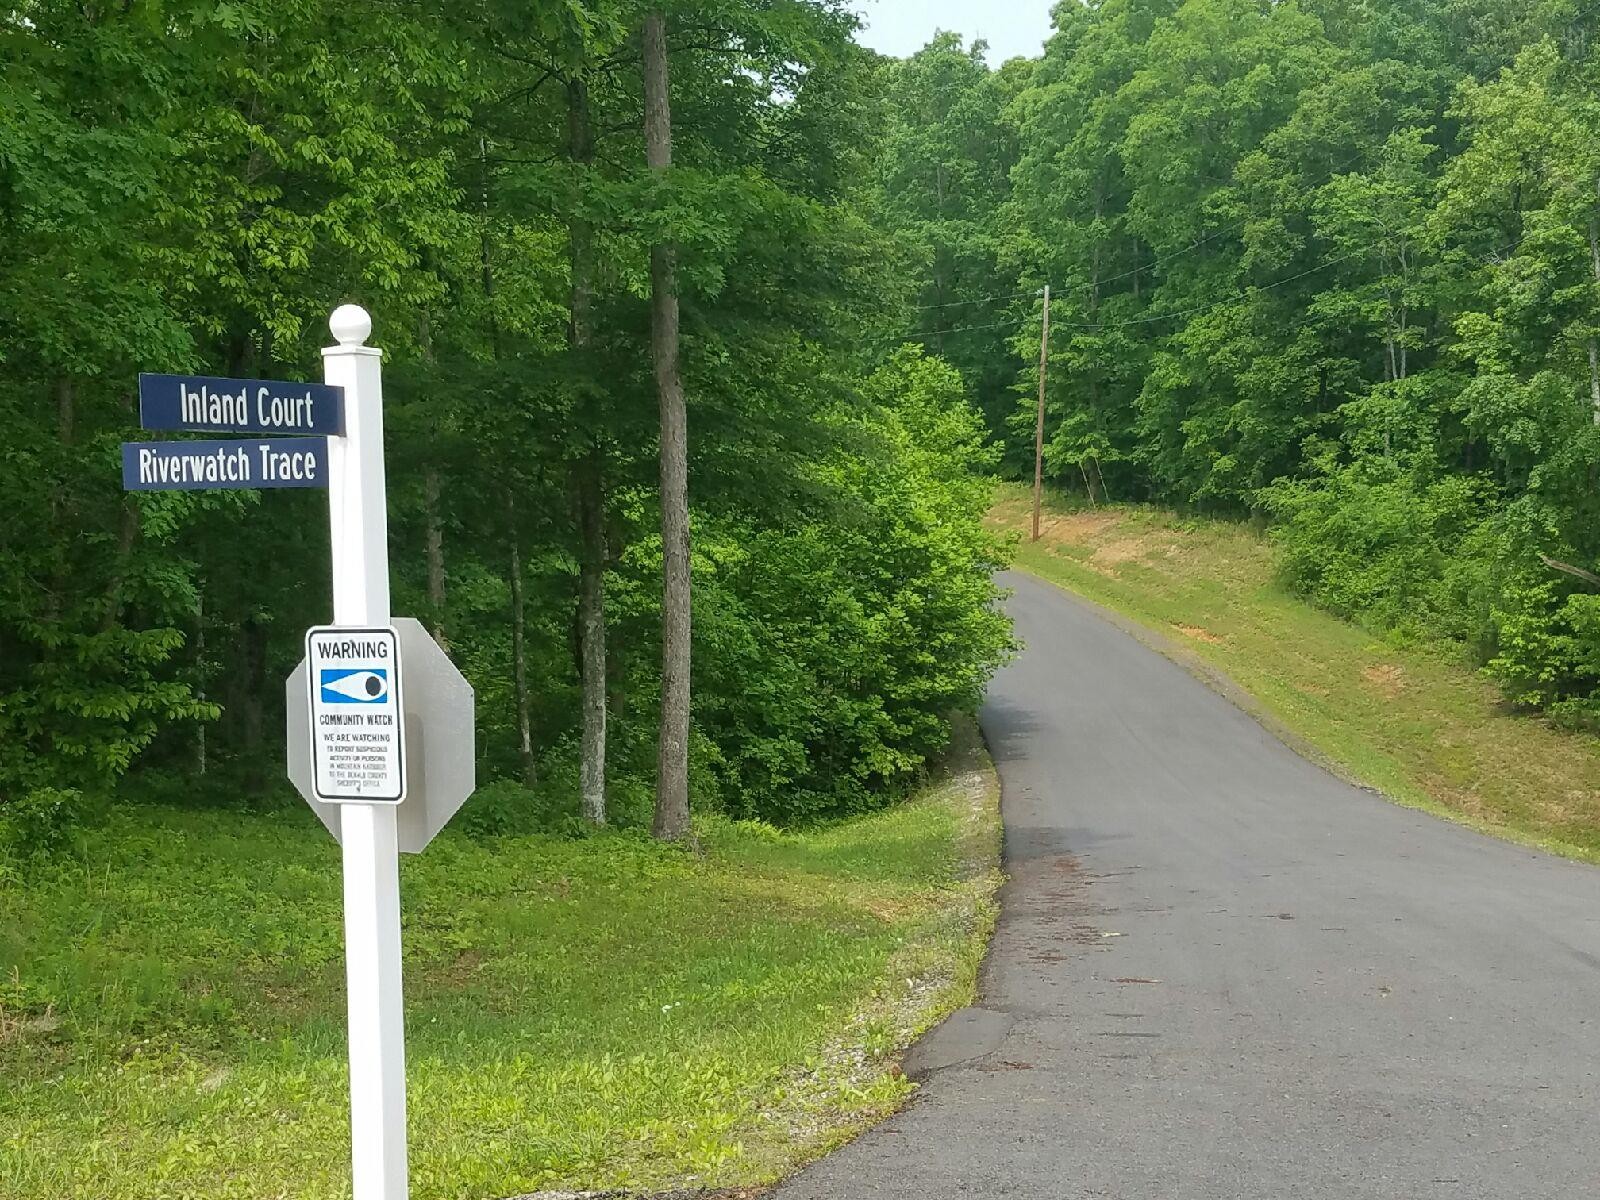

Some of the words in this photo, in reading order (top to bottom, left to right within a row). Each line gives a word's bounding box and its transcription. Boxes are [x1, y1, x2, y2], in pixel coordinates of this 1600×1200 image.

[180, 383, 248, 426] Inland
[257, 387, 314, 428] Court
[139, 447, 250, 484] Riverwatch
[259, 444, 316, 481] Trace
[317, 641, 388, 659] WARNING
[320, 714, 364, 725] COMMUNITY
[367, 714, 393, 725] WATCH
[324, 733, 334, 742] WE
[336, 733, 350, 742] ARE
[352, 733, 390, 742] WATCHING
